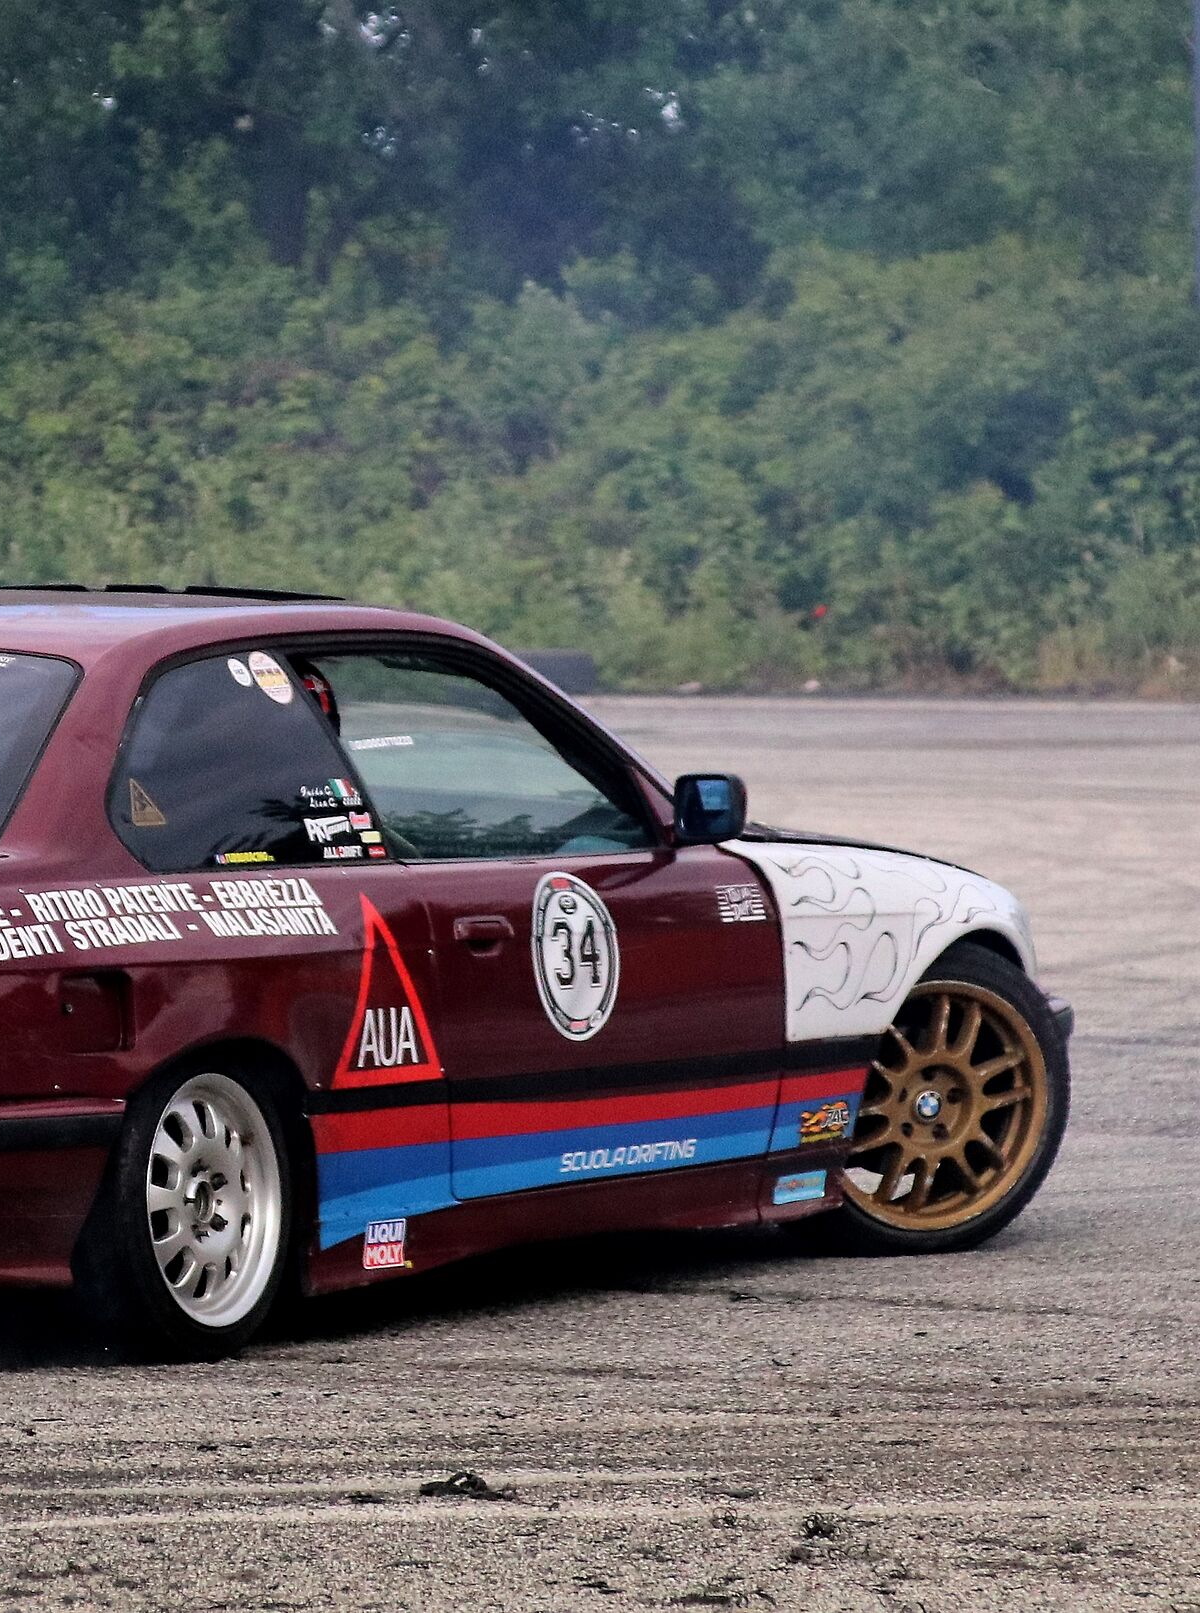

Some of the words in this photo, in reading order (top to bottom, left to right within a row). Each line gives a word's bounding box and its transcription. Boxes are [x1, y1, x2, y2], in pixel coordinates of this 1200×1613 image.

[24, 888, 110, 923] RITIRO
[101, 882, 204, 916] PATENTE
[209, 877, 324, 910] EBBREZZA
[64, 912, 184, 951] STRADALI
[199, 906, 340, 938] MALASANITA
[551, 915, 602, 990] 34
[357, 1006, 419, 1068] AUA
[559, 1147, 627, 1173] SCUOLA
[625, 1138, 698, 1165] DRIFTING
[367, 1221, 403, 1244] LIQUI
[366, 1244, 403, 1267] MOLY
